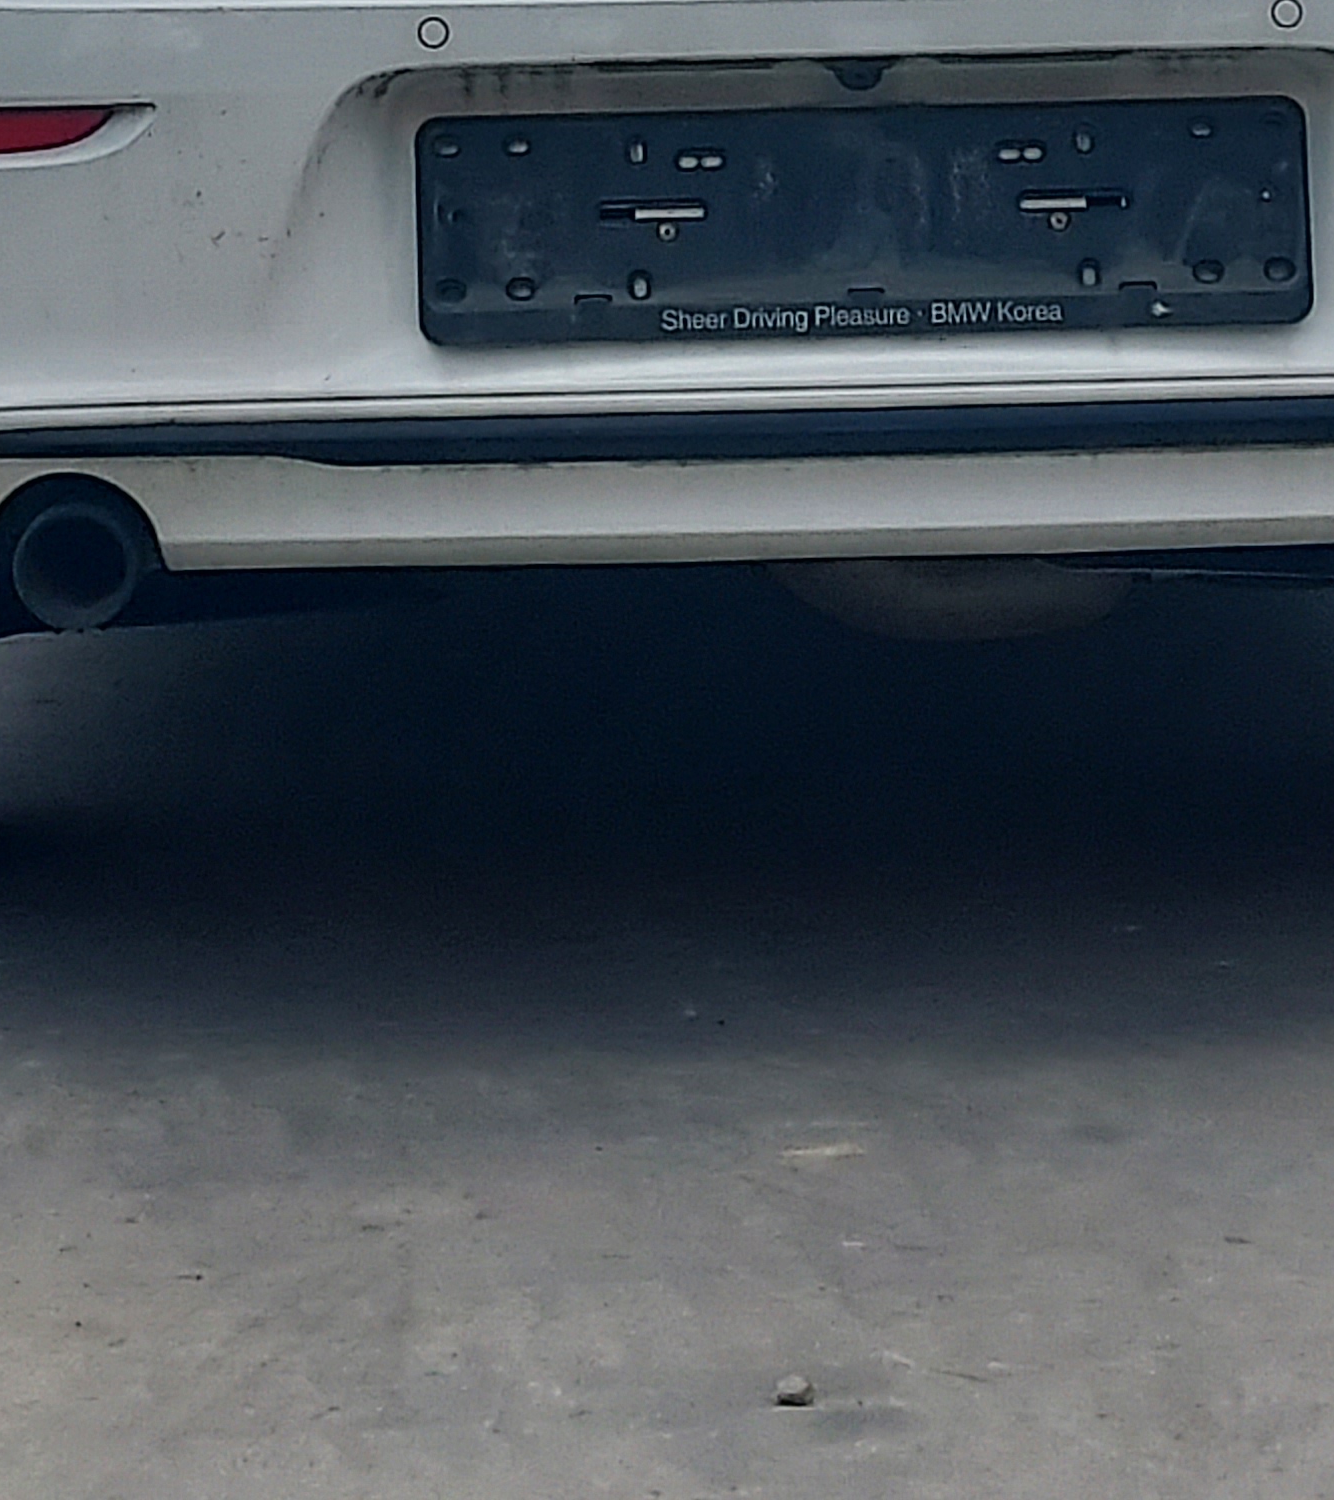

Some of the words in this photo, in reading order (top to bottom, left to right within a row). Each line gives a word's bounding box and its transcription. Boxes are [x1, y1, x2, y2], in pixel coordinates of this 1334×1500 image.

[661, 308, 728, 331] Sheer
[733, 307, 809, 333] Driving
[814, 304, 911, 326] Pleasure
[930, 302, 992, 325] BMW
[997, 300, 1064, 322] Korea
